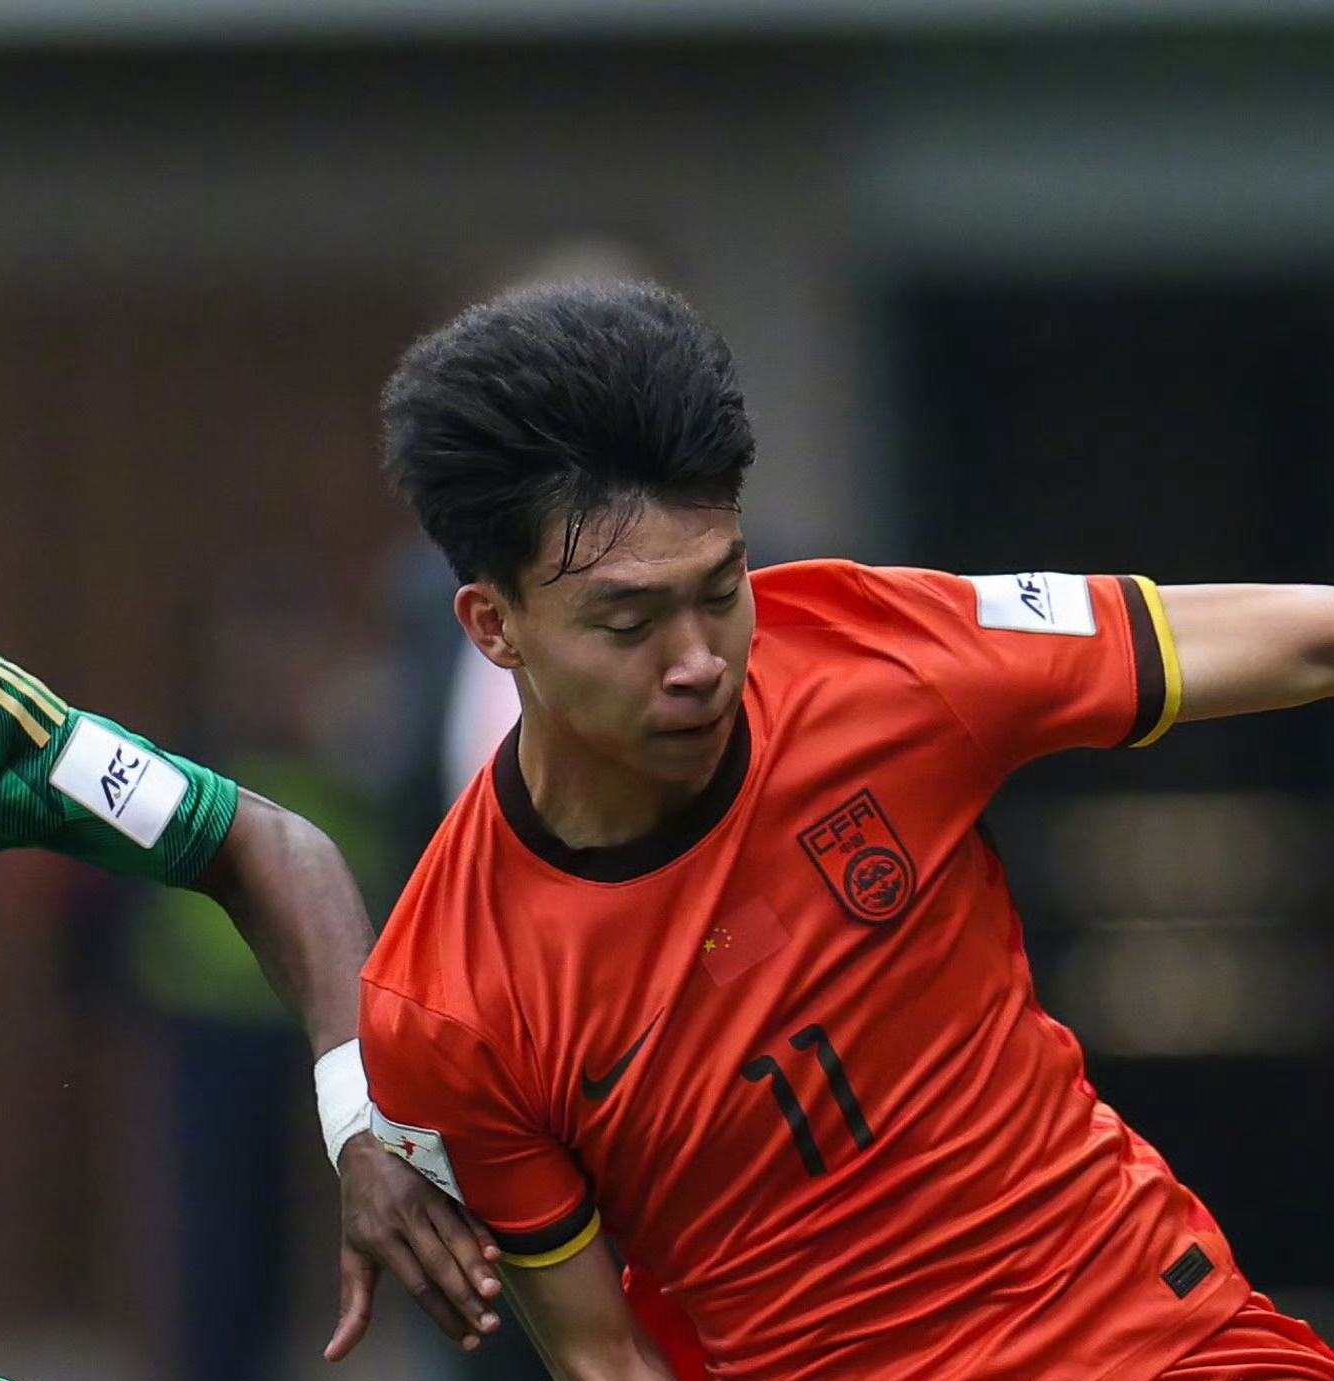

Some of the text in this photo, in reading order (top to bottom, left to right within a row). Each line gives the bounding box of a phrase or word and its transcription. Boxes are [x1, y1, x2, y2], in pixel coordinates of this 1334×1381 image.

[1016, 569, 1046, 621] AF
[100, 743, 140, 812] AFC
[809, 800, 875, 855] CFA
[740, 1023, 875, 1177] 11
